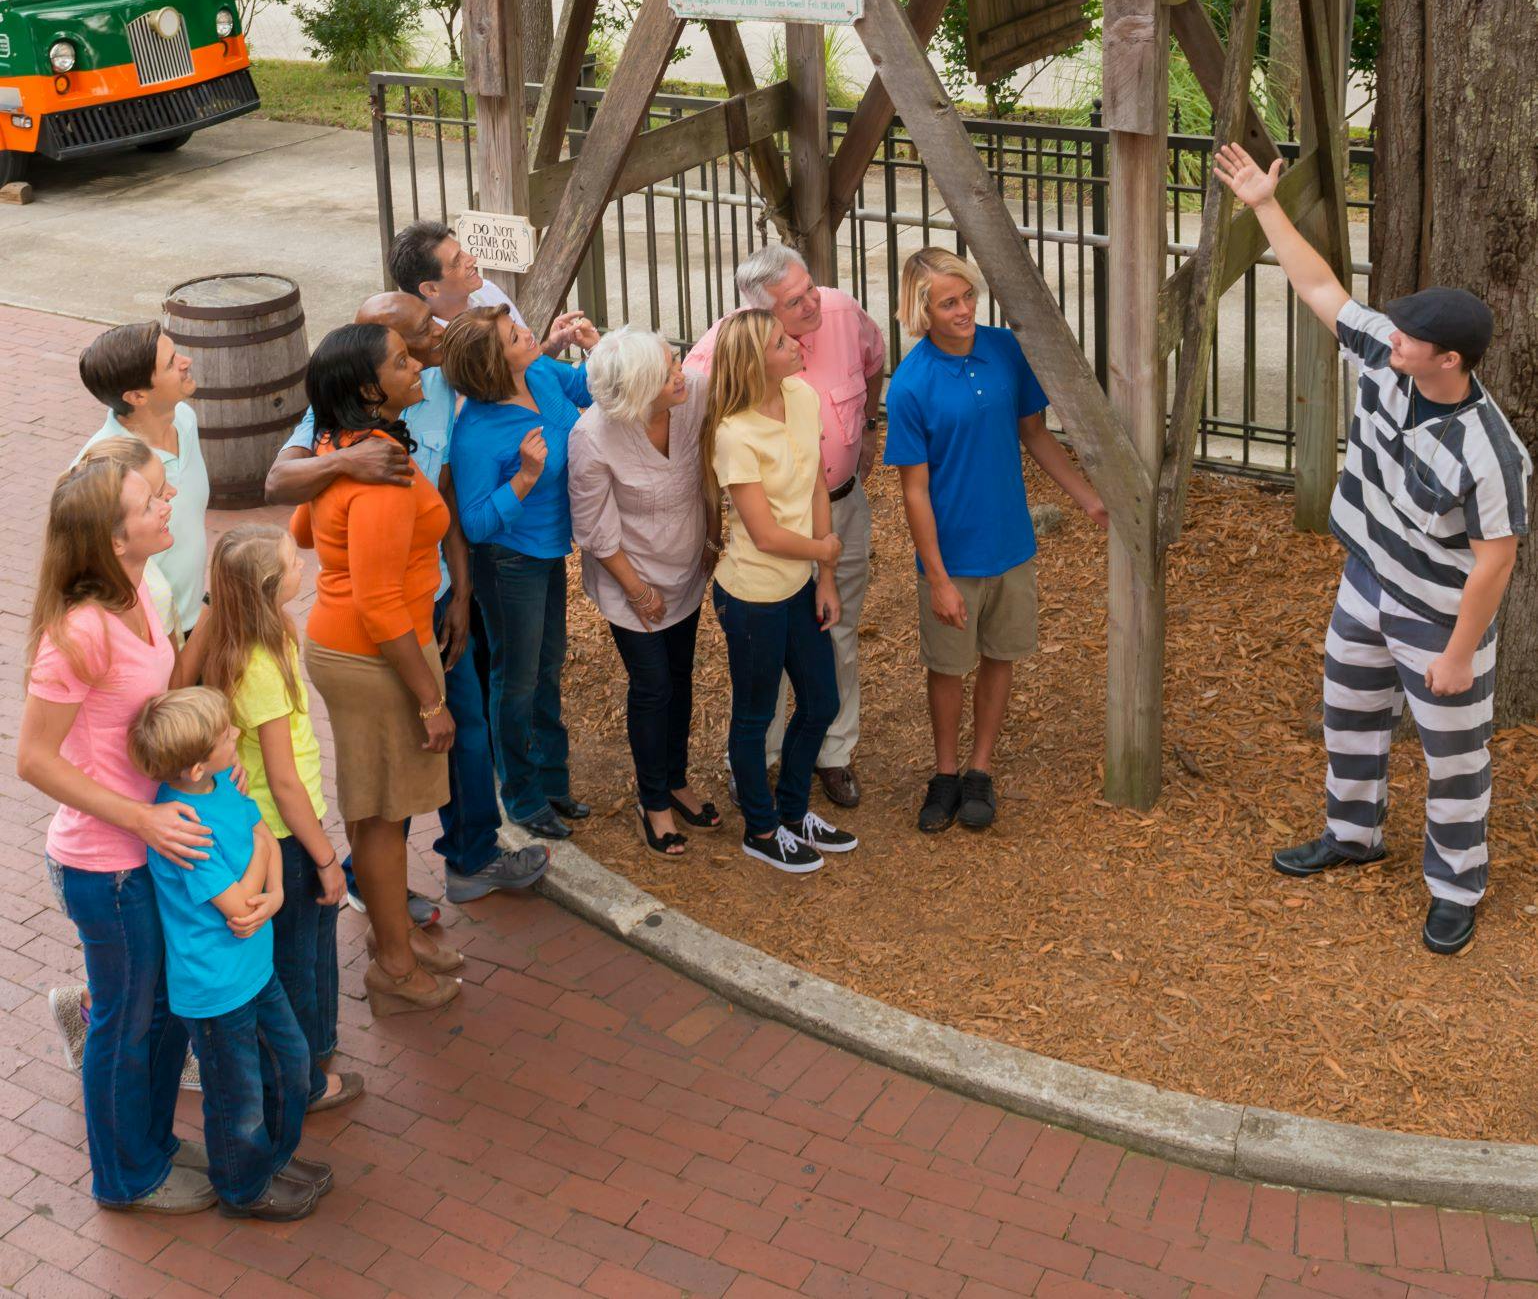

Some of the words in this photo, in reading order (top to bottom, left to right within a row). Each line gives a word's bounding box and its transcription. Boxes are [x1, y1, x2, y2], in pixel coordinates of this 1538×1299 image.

[473, 223, 490, 236] DO
[493, 225, 515, 238] NOT
[467, 235, 499, 248] CLIMB
[502, 238, 518, 250] ON
[469, 246, 519, 264] GALLOWS
